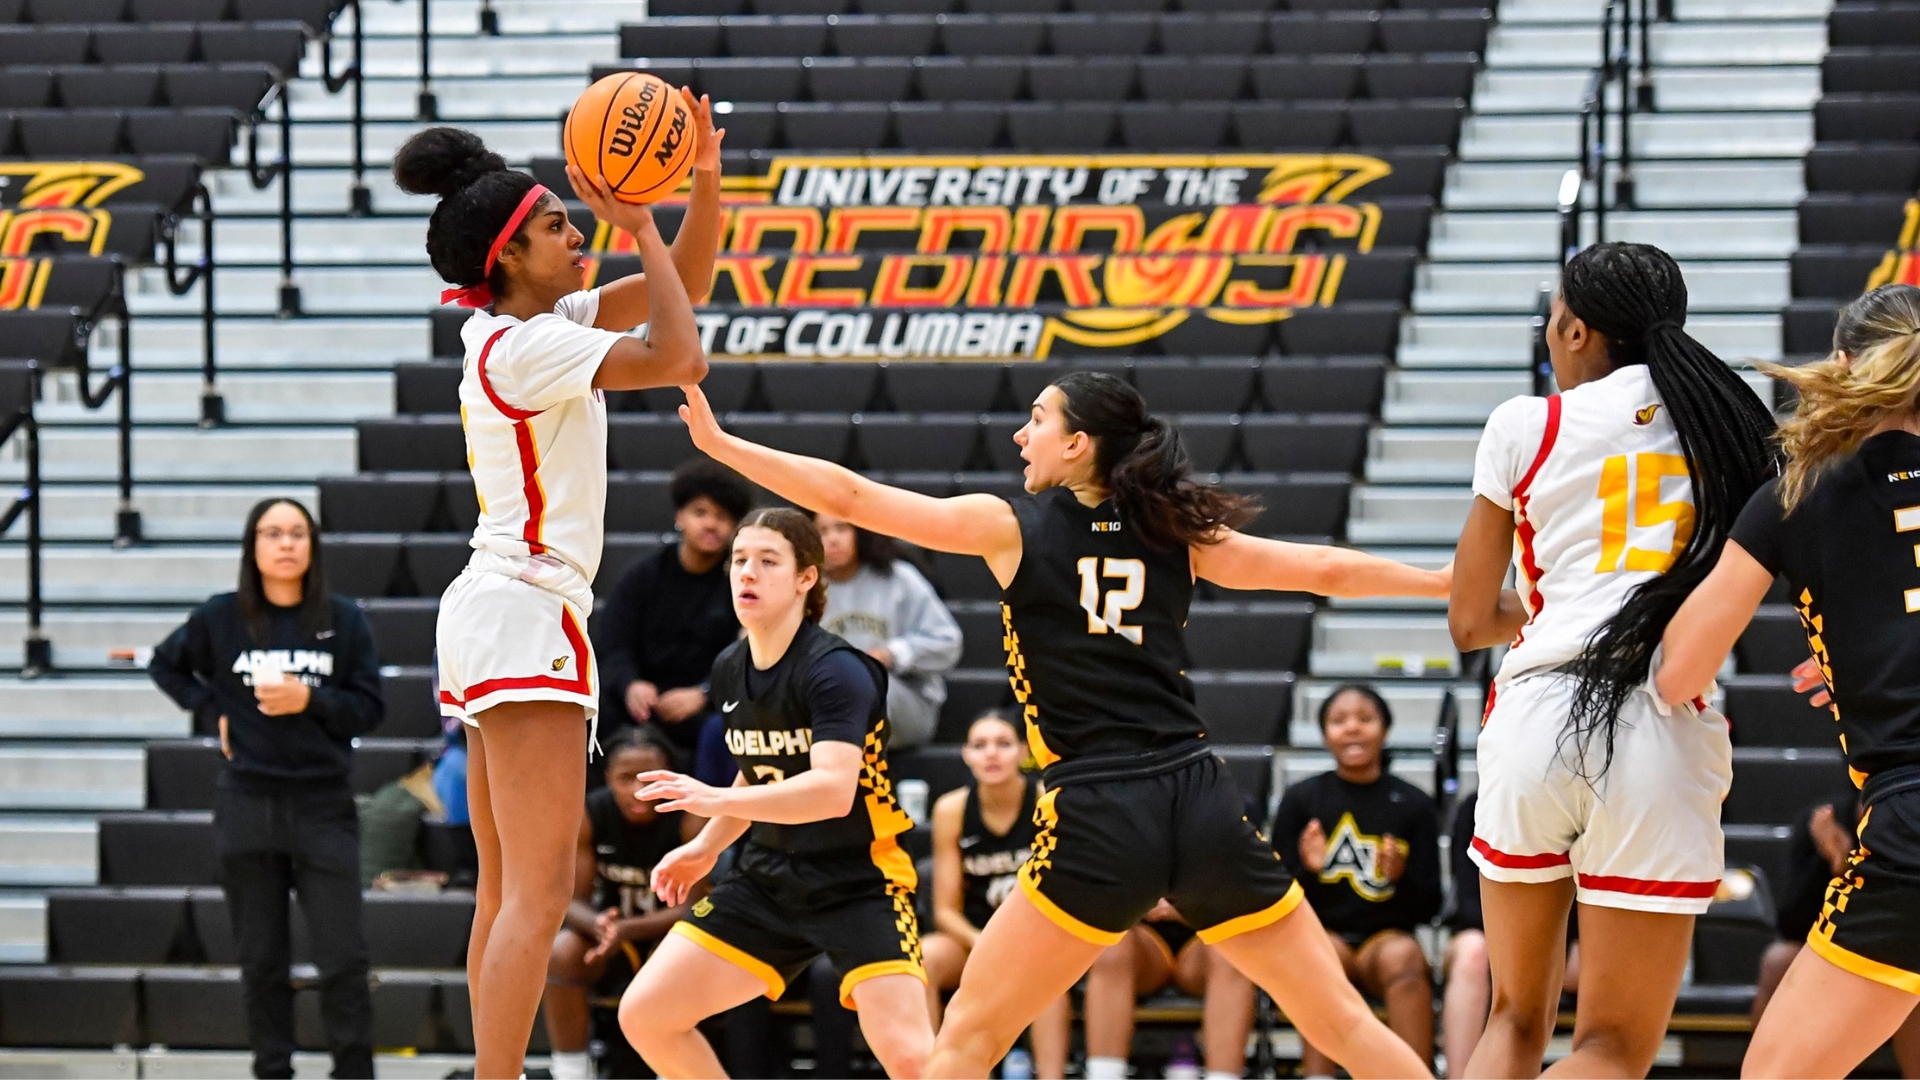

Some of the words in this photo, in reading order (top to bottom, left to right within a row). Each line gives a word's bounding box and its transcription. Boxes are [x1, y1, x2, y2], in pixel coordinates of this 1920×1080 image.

[608, 81, 660, 158] Wilson
[654, 105, 688, 168] NCAA
[778, 165, 1089, 206] UNIVERSITY
[1099, 167, 1157, 206] OF
[1164, 167, 1249, 206] THE
[725, 315, 787, 355] OF
[784, 310, 1044, 358] COLUMBIA
[1091, 521, 1121, 532] NE10
[1595, 452, 1698, 574] 15
[1077, 556, 1146, 645] 12
